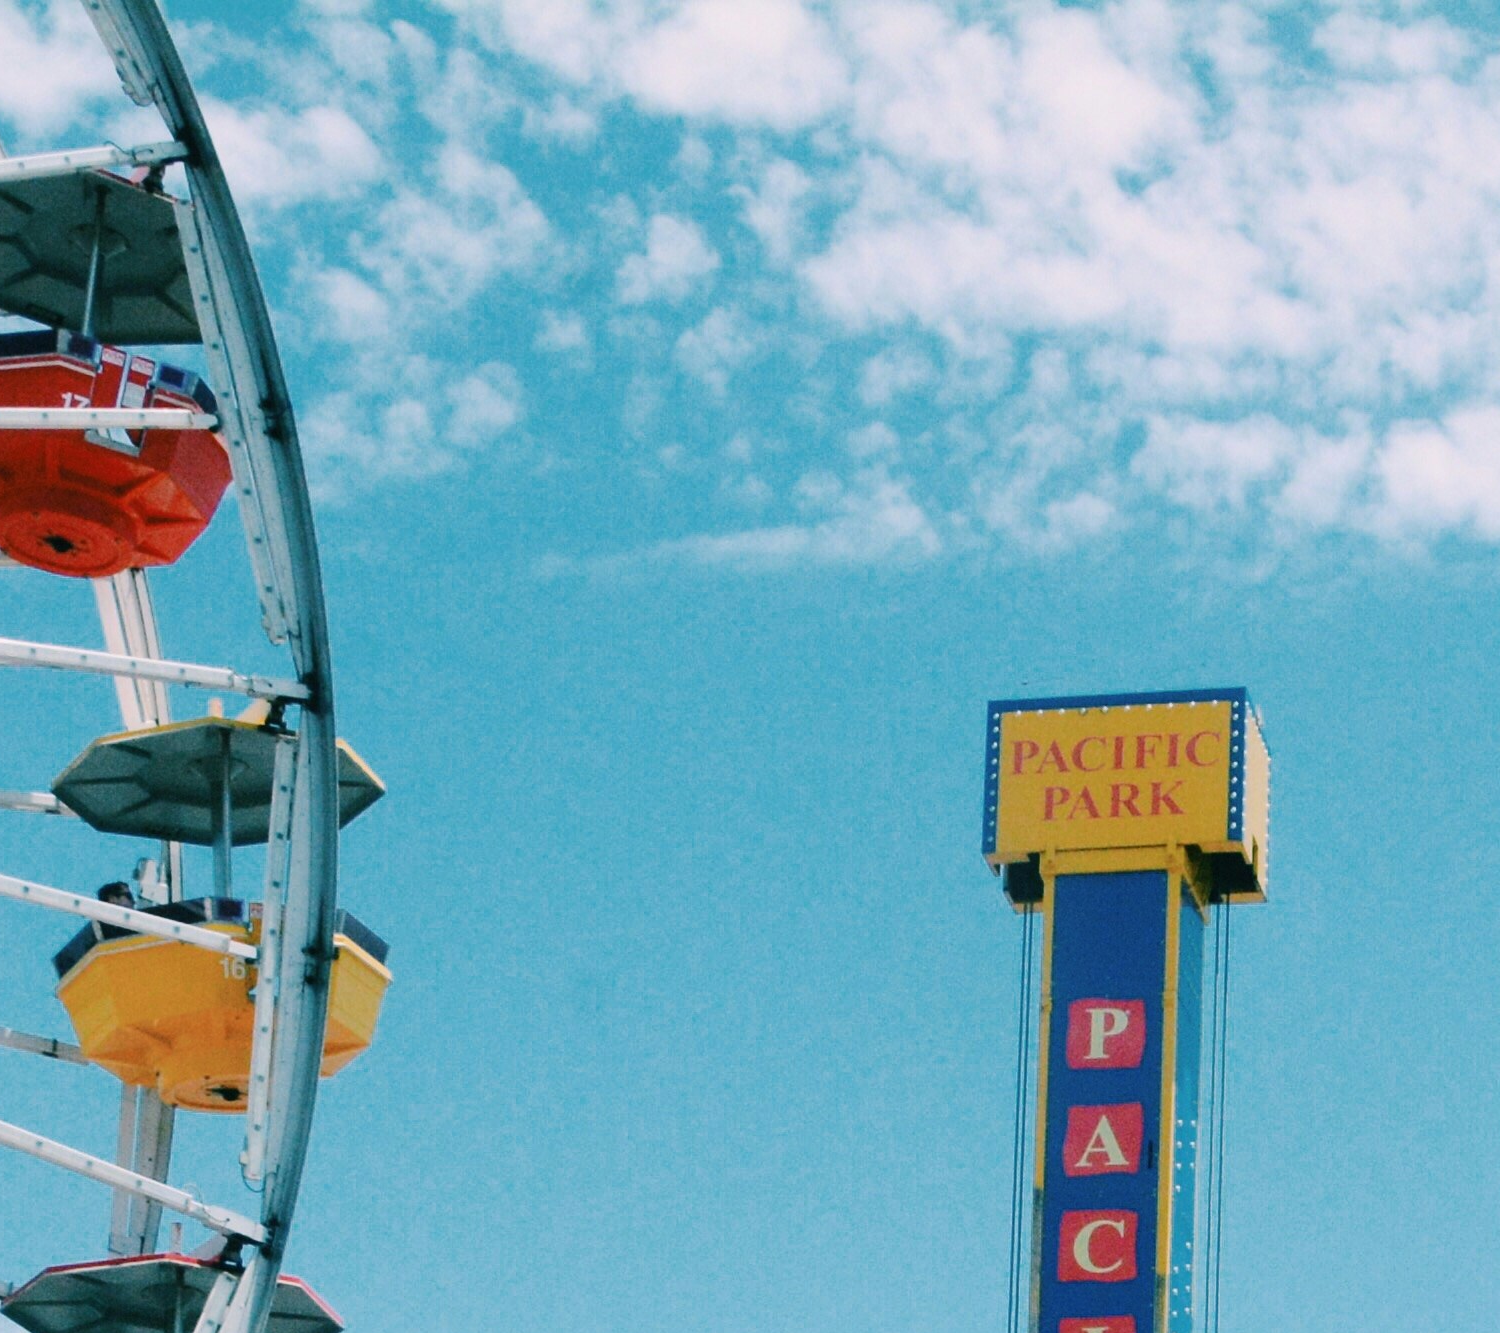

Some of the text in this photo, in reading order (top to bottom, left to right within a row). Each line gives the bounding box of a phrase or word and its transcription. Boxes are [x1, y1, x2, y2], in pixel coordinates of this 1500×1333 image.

[1010, 730, 1221, 775] PACIFIC
[1043, 780, 1187, 821] PARK
[219, 956, 246, 979] 16
